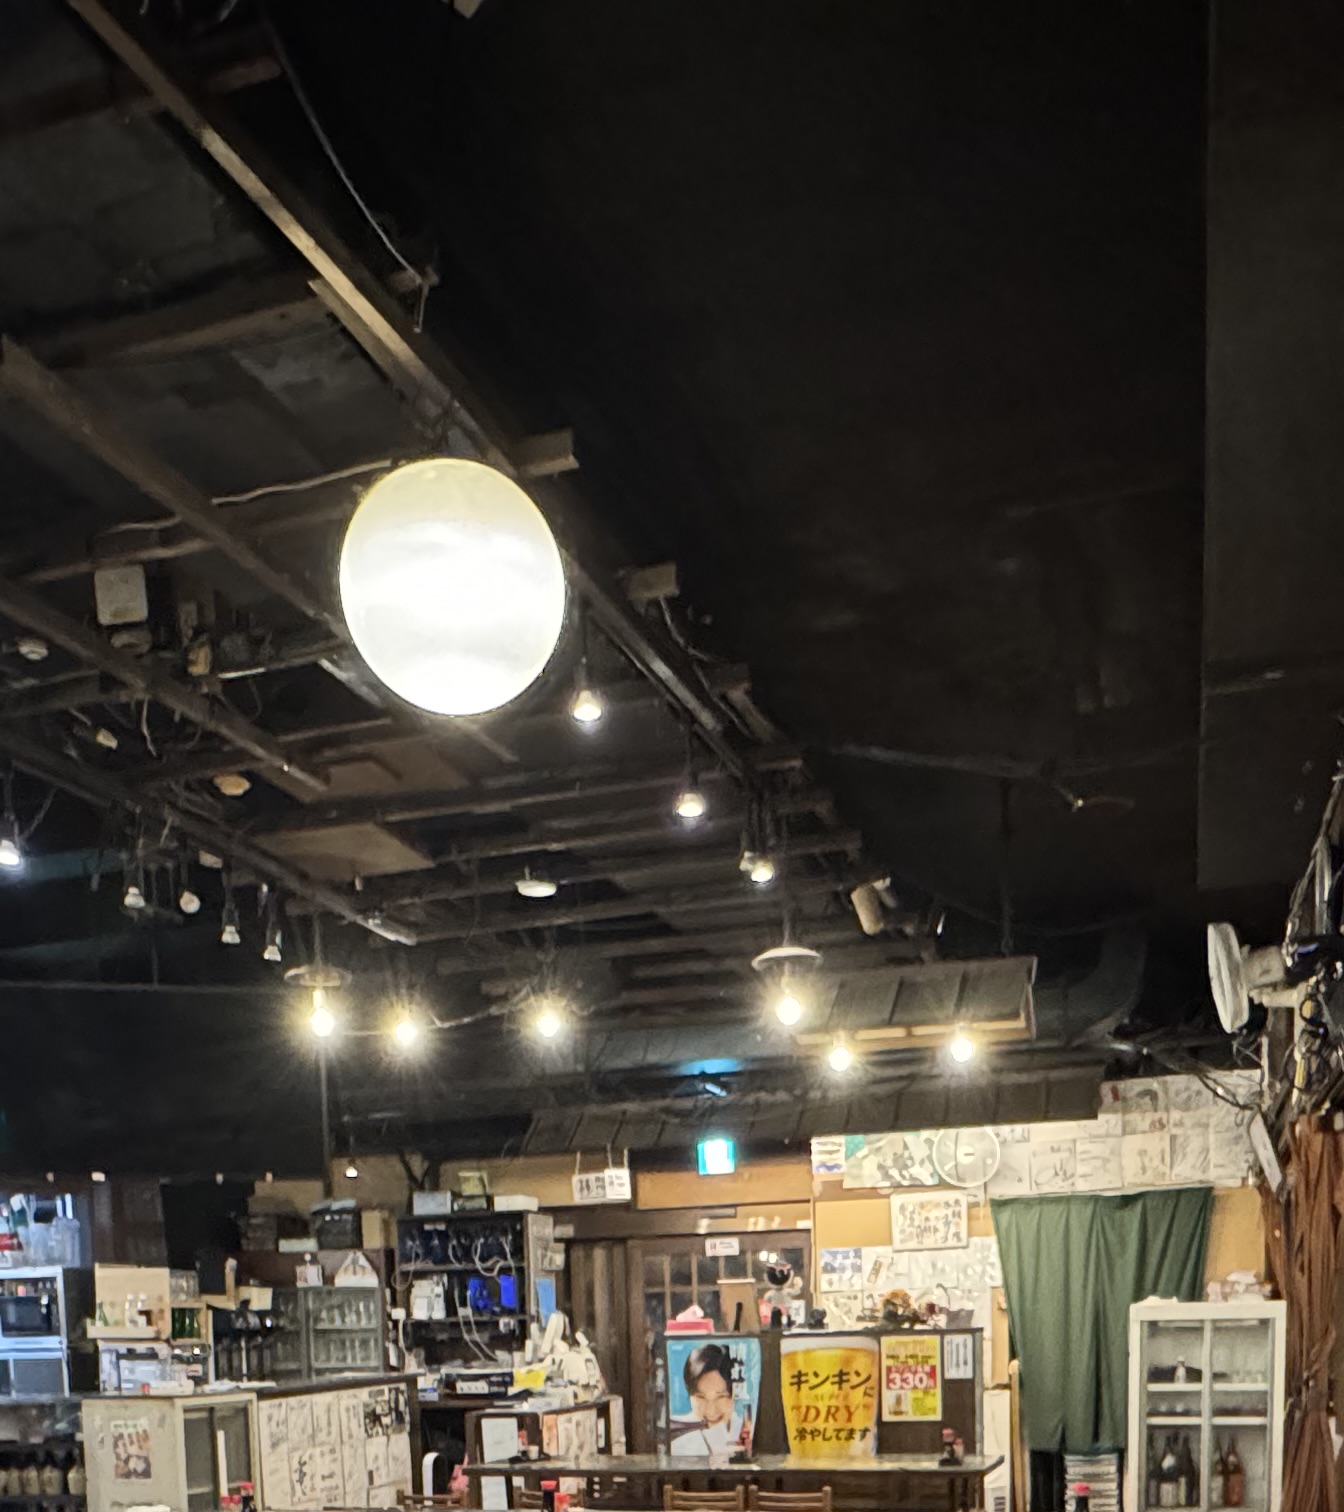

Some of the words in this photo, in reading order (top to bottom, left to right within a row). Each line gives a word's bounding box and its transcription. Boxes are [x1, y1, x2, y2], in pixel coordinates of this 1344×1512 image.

[794, 1427, 871, 1442] 冷やしてます
